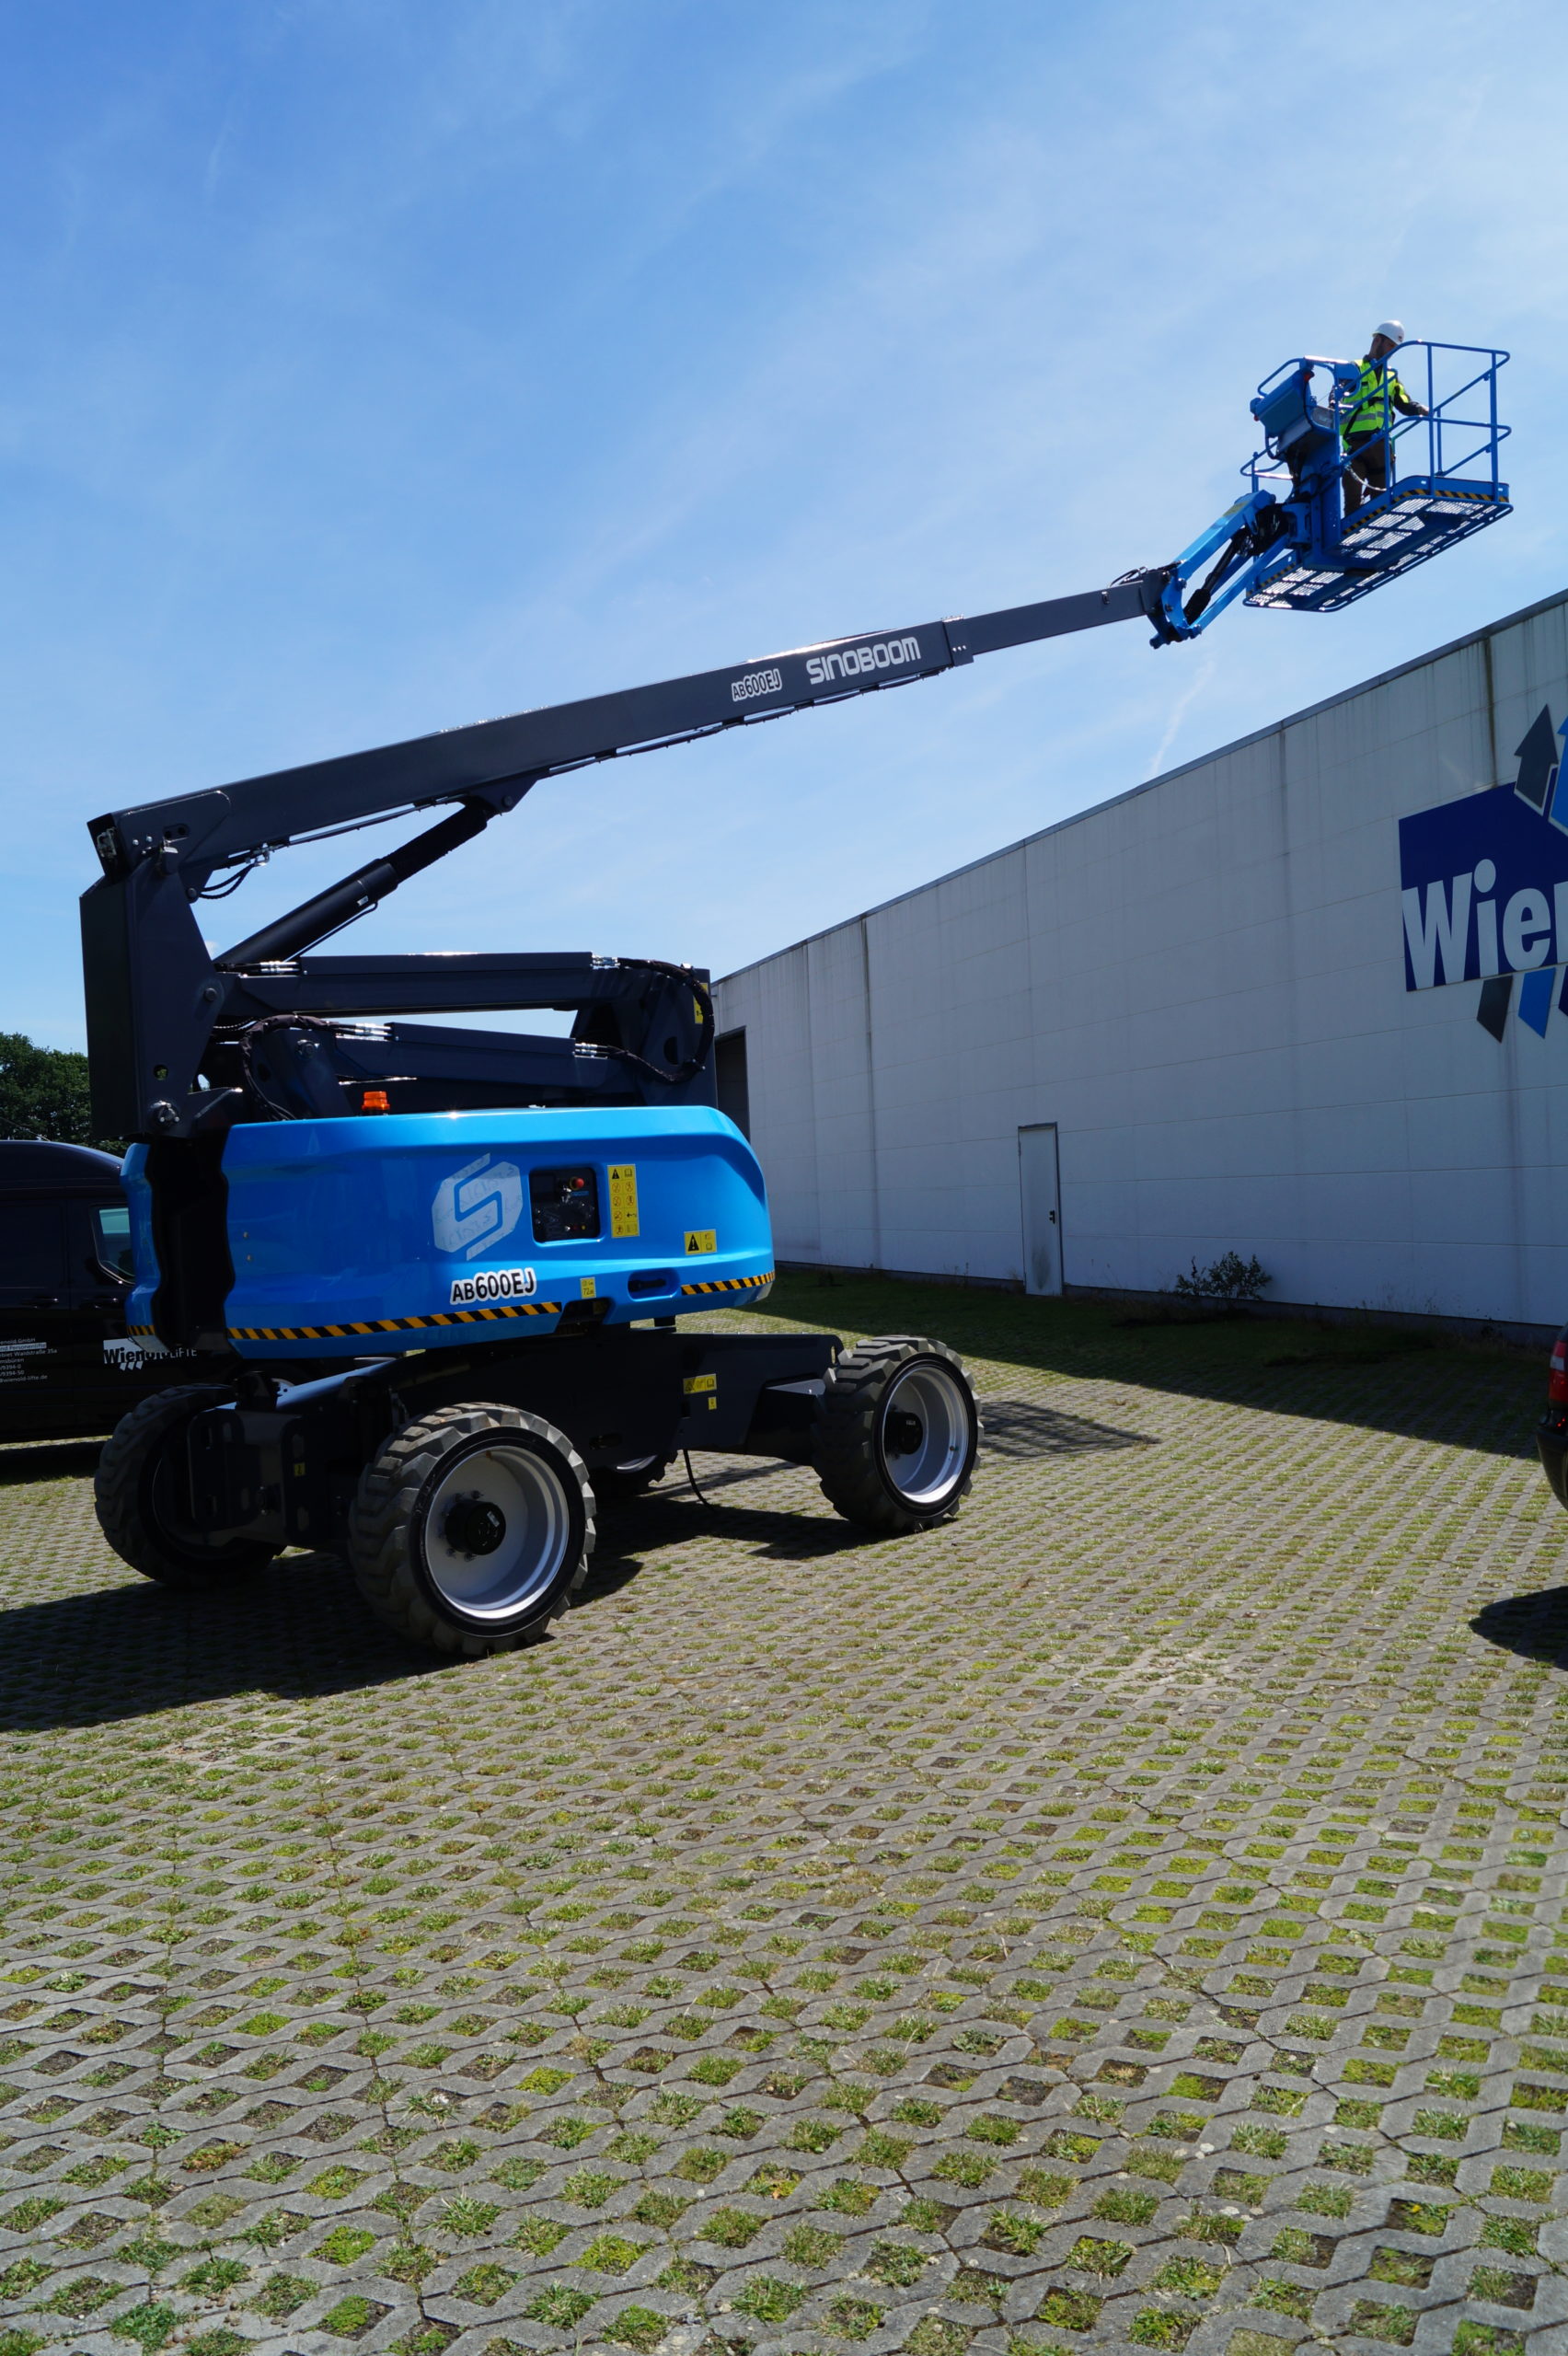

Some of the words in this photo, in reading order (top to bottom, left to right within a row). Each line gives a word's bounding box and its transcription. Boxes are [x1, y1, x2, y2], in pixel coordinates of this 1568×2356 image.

[806, 636, 921, 685] SINOBOOM
[732, 669, 781, 700] AB600EJ
[1402, 859, 1568, 989] Wie
[451, 1268, 536, 1303] AB600EJ
